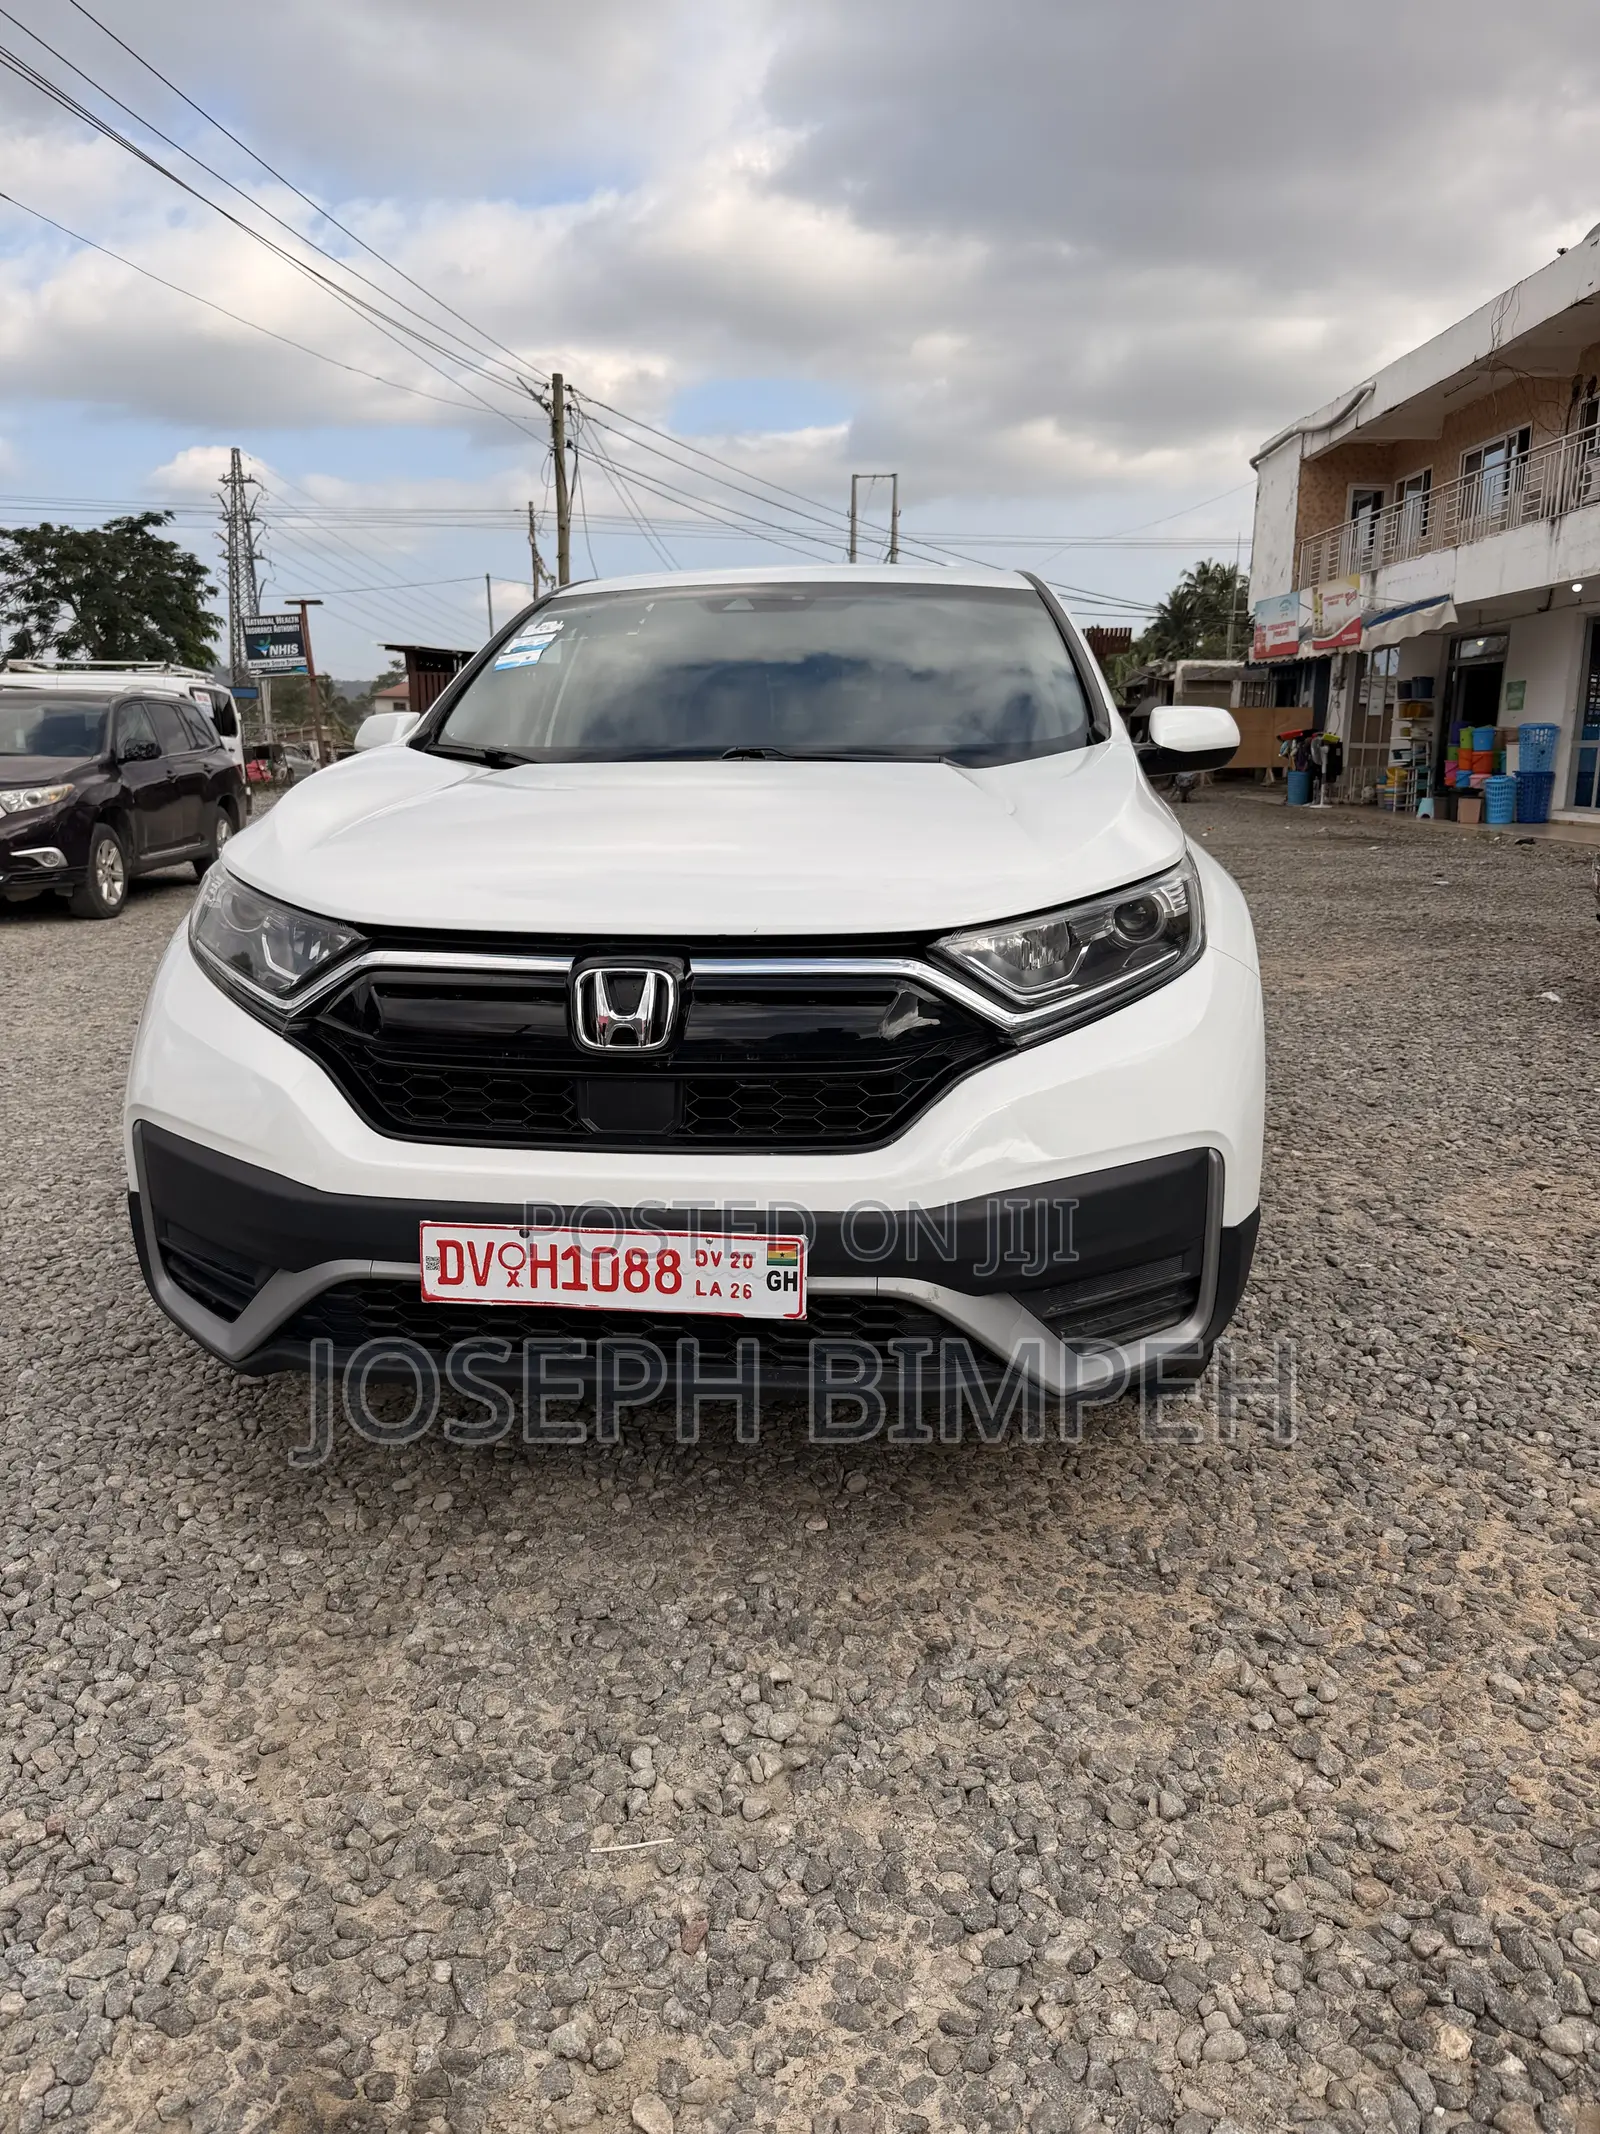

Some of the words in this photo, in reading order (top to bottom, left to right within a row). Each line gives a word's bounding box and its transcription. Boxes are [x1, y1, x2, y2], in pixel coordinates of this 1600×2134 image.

[269, 643, 299, 656] NHIS
[436, 1239, 495, 1287] DV
[529, 1243, 683, 1295] H1088
[695, 1250, 723, 1268] DV
[730, 1251, 754, 1270] 20
[695, 1279, 723, 1298] LA
[730, 1282, 753, 1300] 26
[766, 1270, 798, 1292] GH
